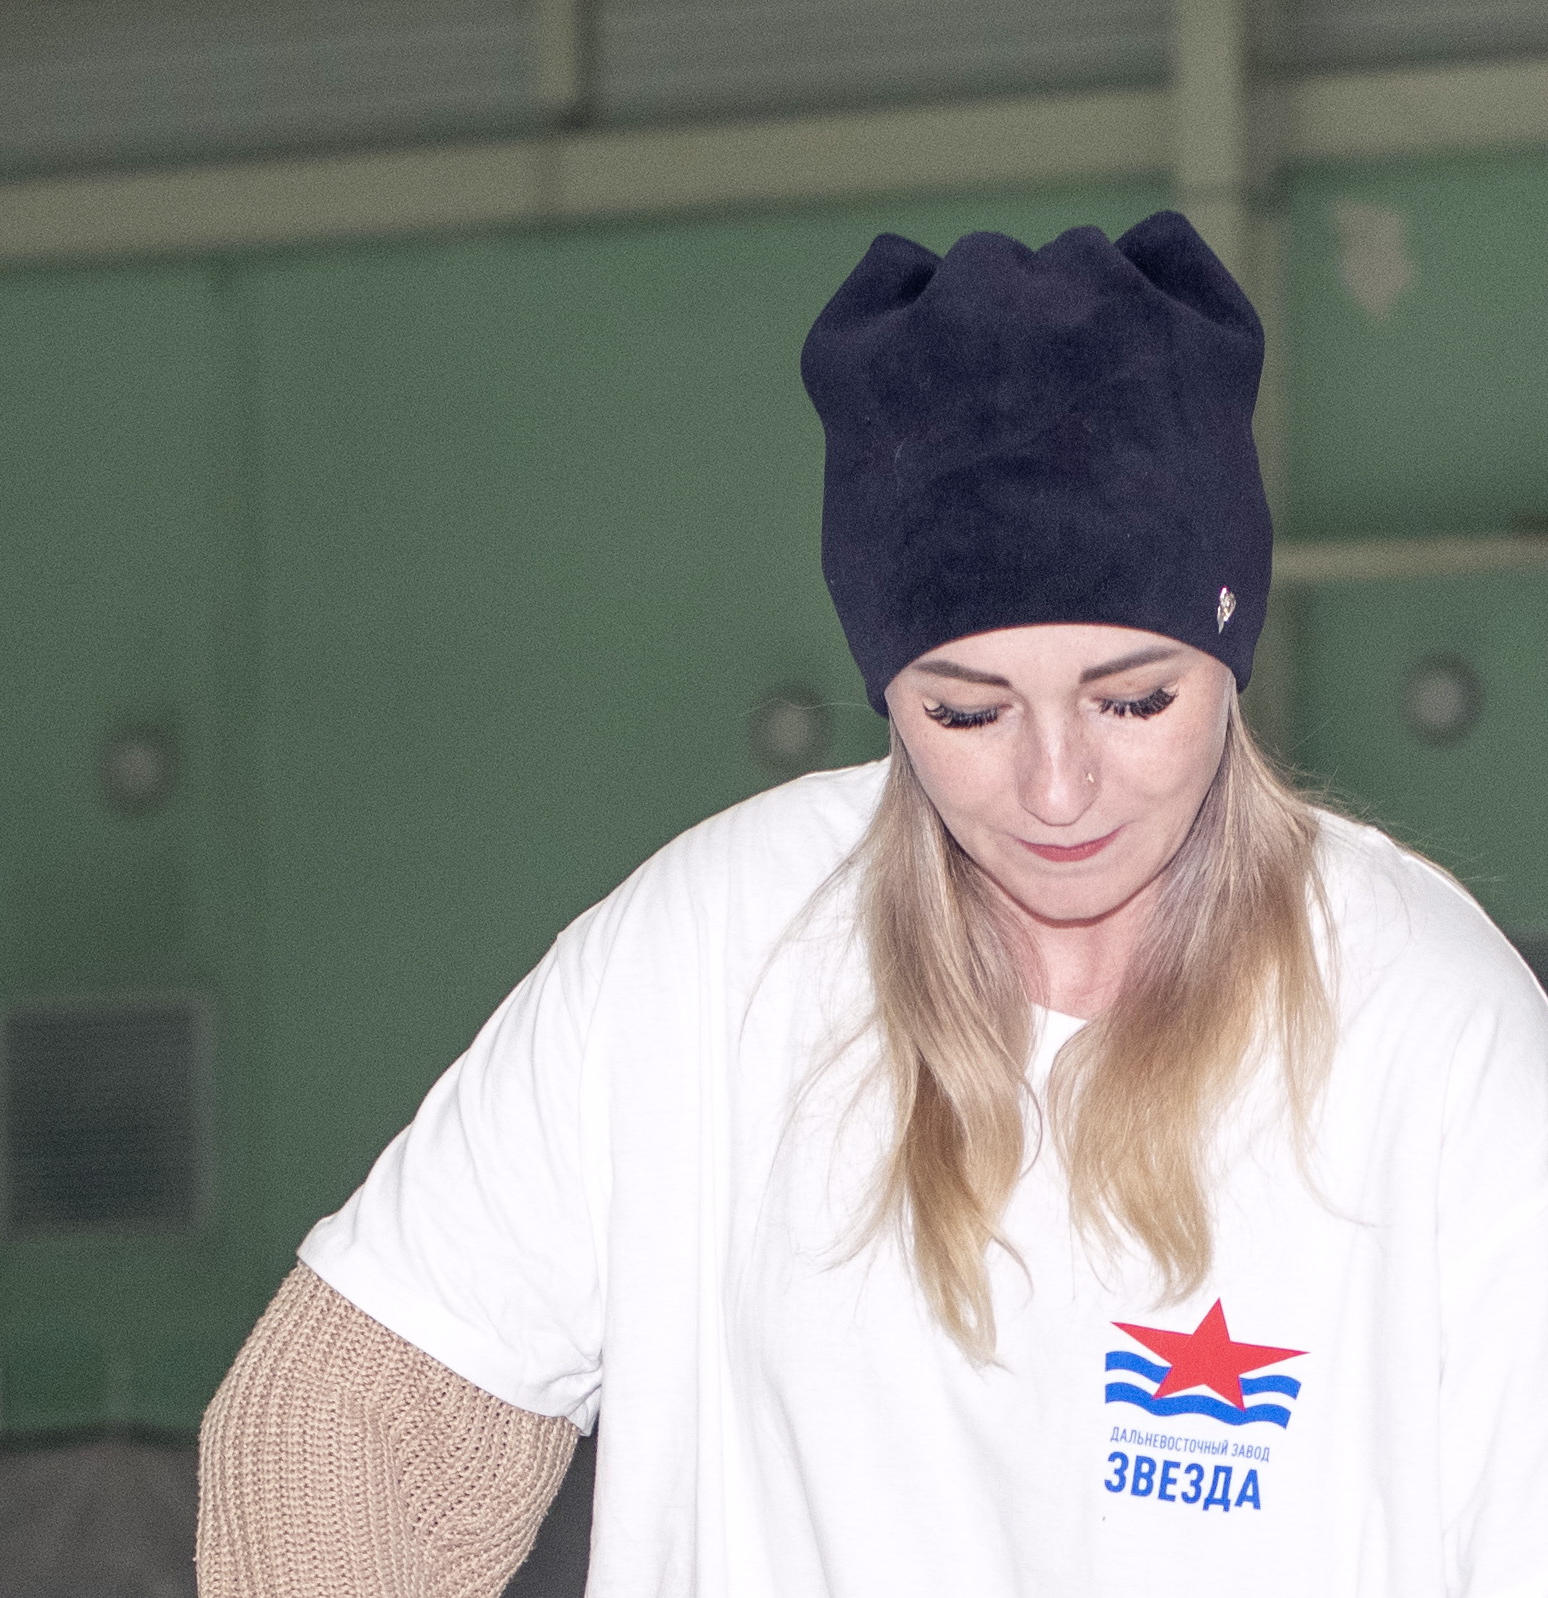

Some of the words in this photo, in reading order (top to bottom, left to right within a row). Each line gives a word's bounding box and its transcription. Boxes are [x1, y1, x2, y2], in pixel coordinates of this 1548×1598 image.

[1110, 1426, 1229, 1456] ДАЛЬНЕВОСТОЧНЫЙ
[1231, 1443, 1271, 1463] ЗАВОД
[1104, 1451, 1262, 1513] ЗВЕЗДА
